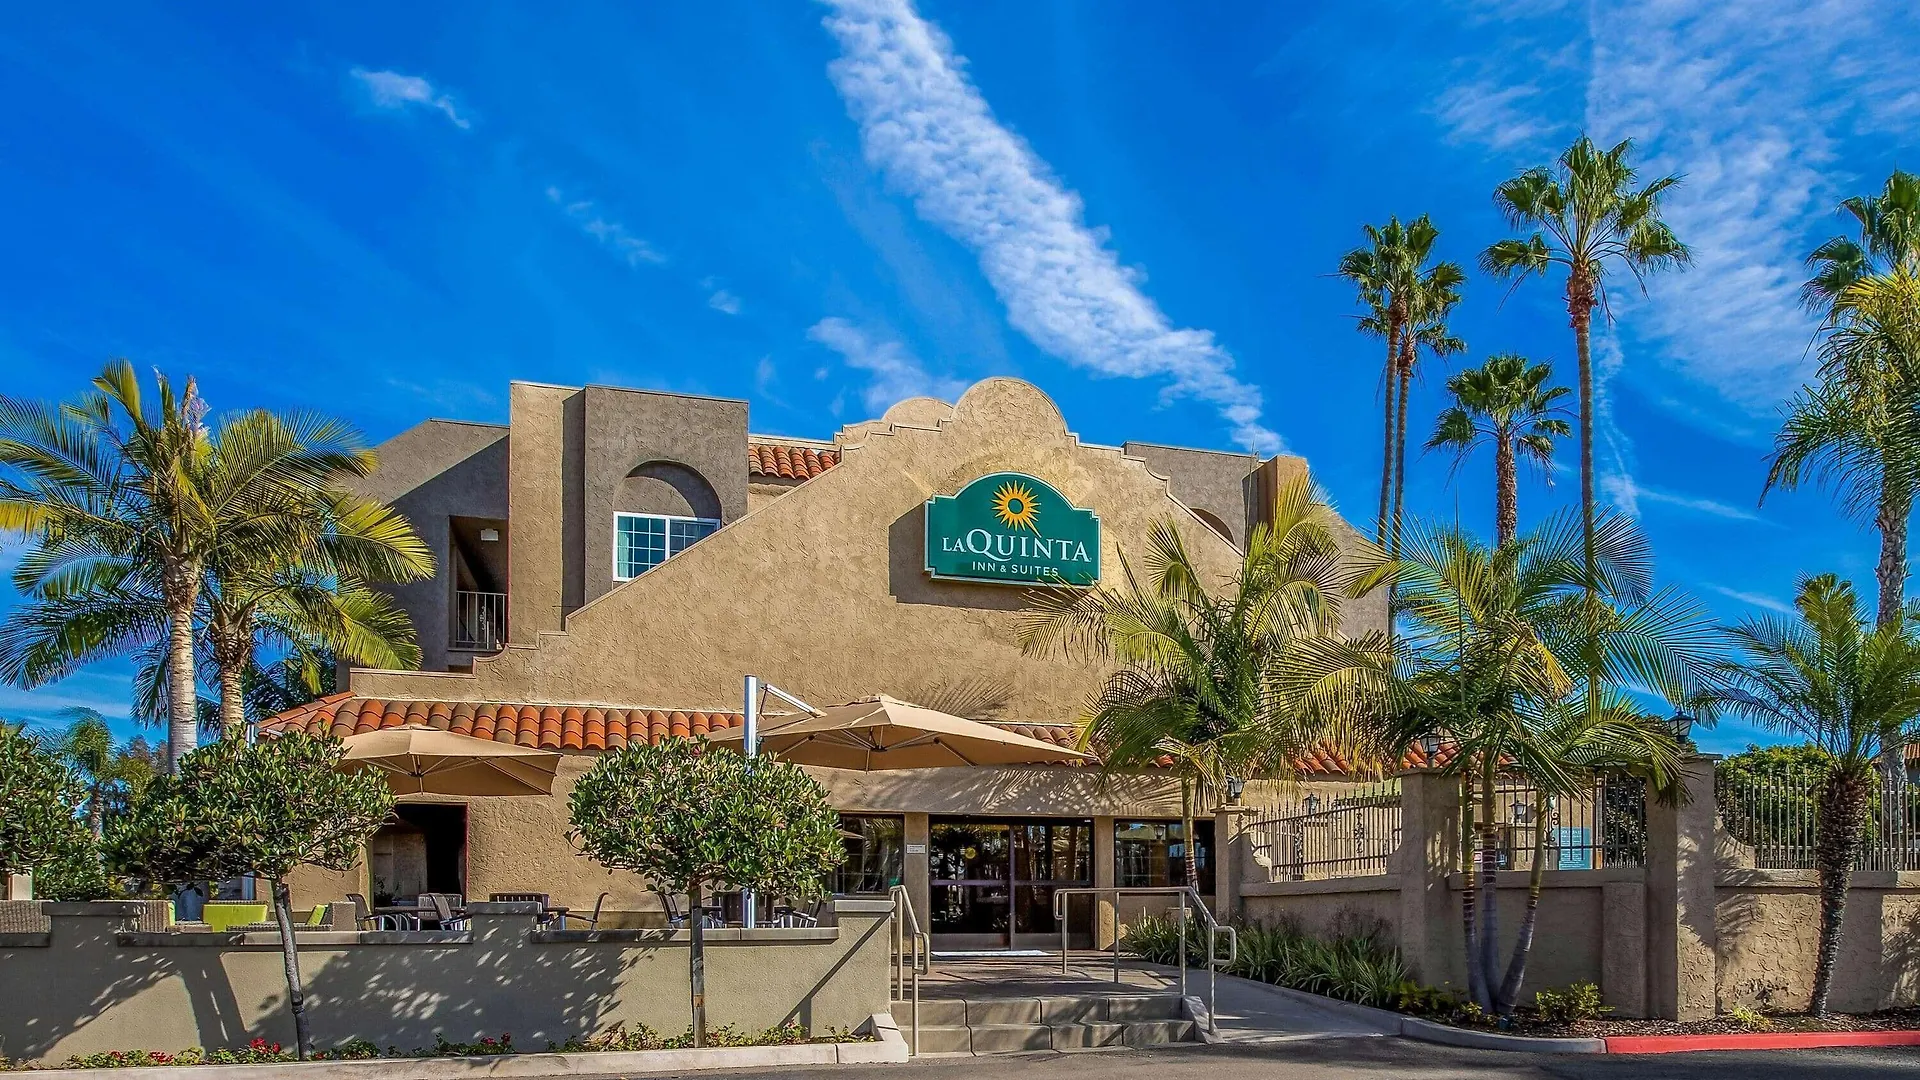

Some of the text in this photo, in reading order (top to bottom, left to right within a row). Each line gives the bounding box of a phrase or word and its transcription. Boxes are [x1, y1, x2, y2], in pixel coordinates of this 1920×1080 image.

[966, 528, 1092, 562] QUINTA
[972, 561, 1059, 577] INN & SUITES
